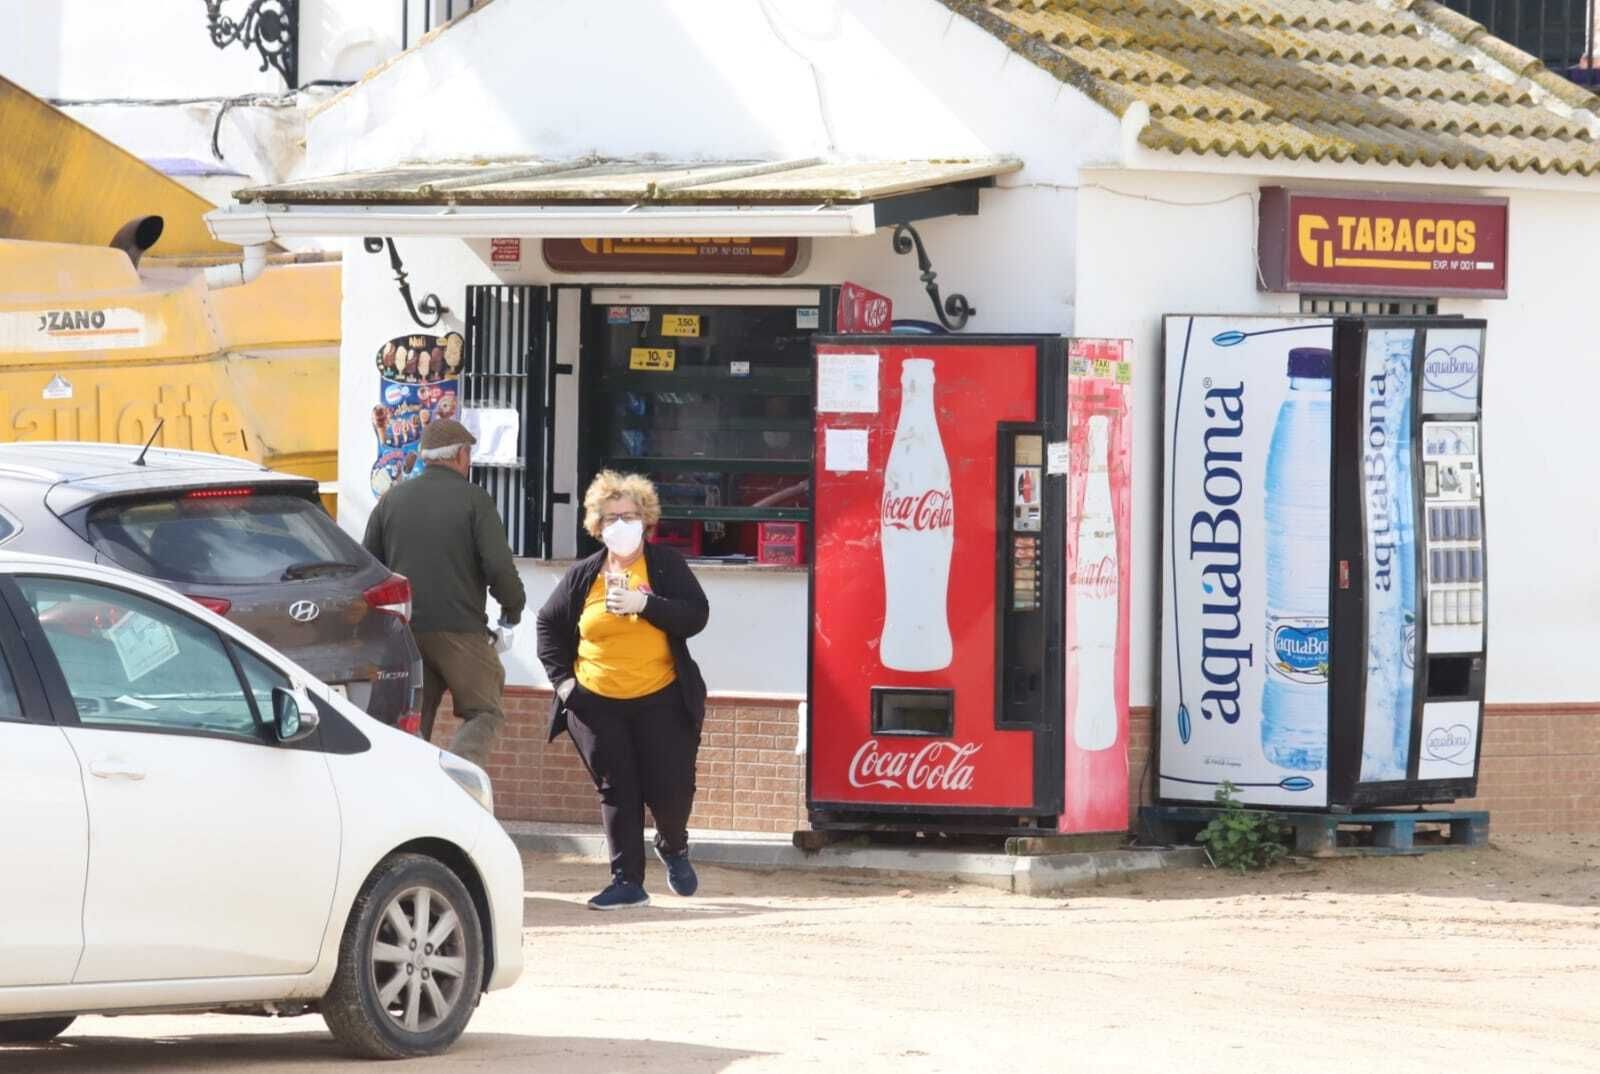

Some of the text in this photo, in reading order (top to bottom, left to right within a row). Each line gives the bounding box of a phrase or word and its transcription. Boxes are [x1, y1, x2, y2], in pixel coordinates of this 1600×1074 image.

[1337, 216, 1476, 254] TABACOS
[1460, 260, 1474, 271] 001
[1364, 373, 1396, 593] aquaBona
[1190, 381, 1252, 725] aquaBona
[849, 739, 983, 790] Coca-Cola
